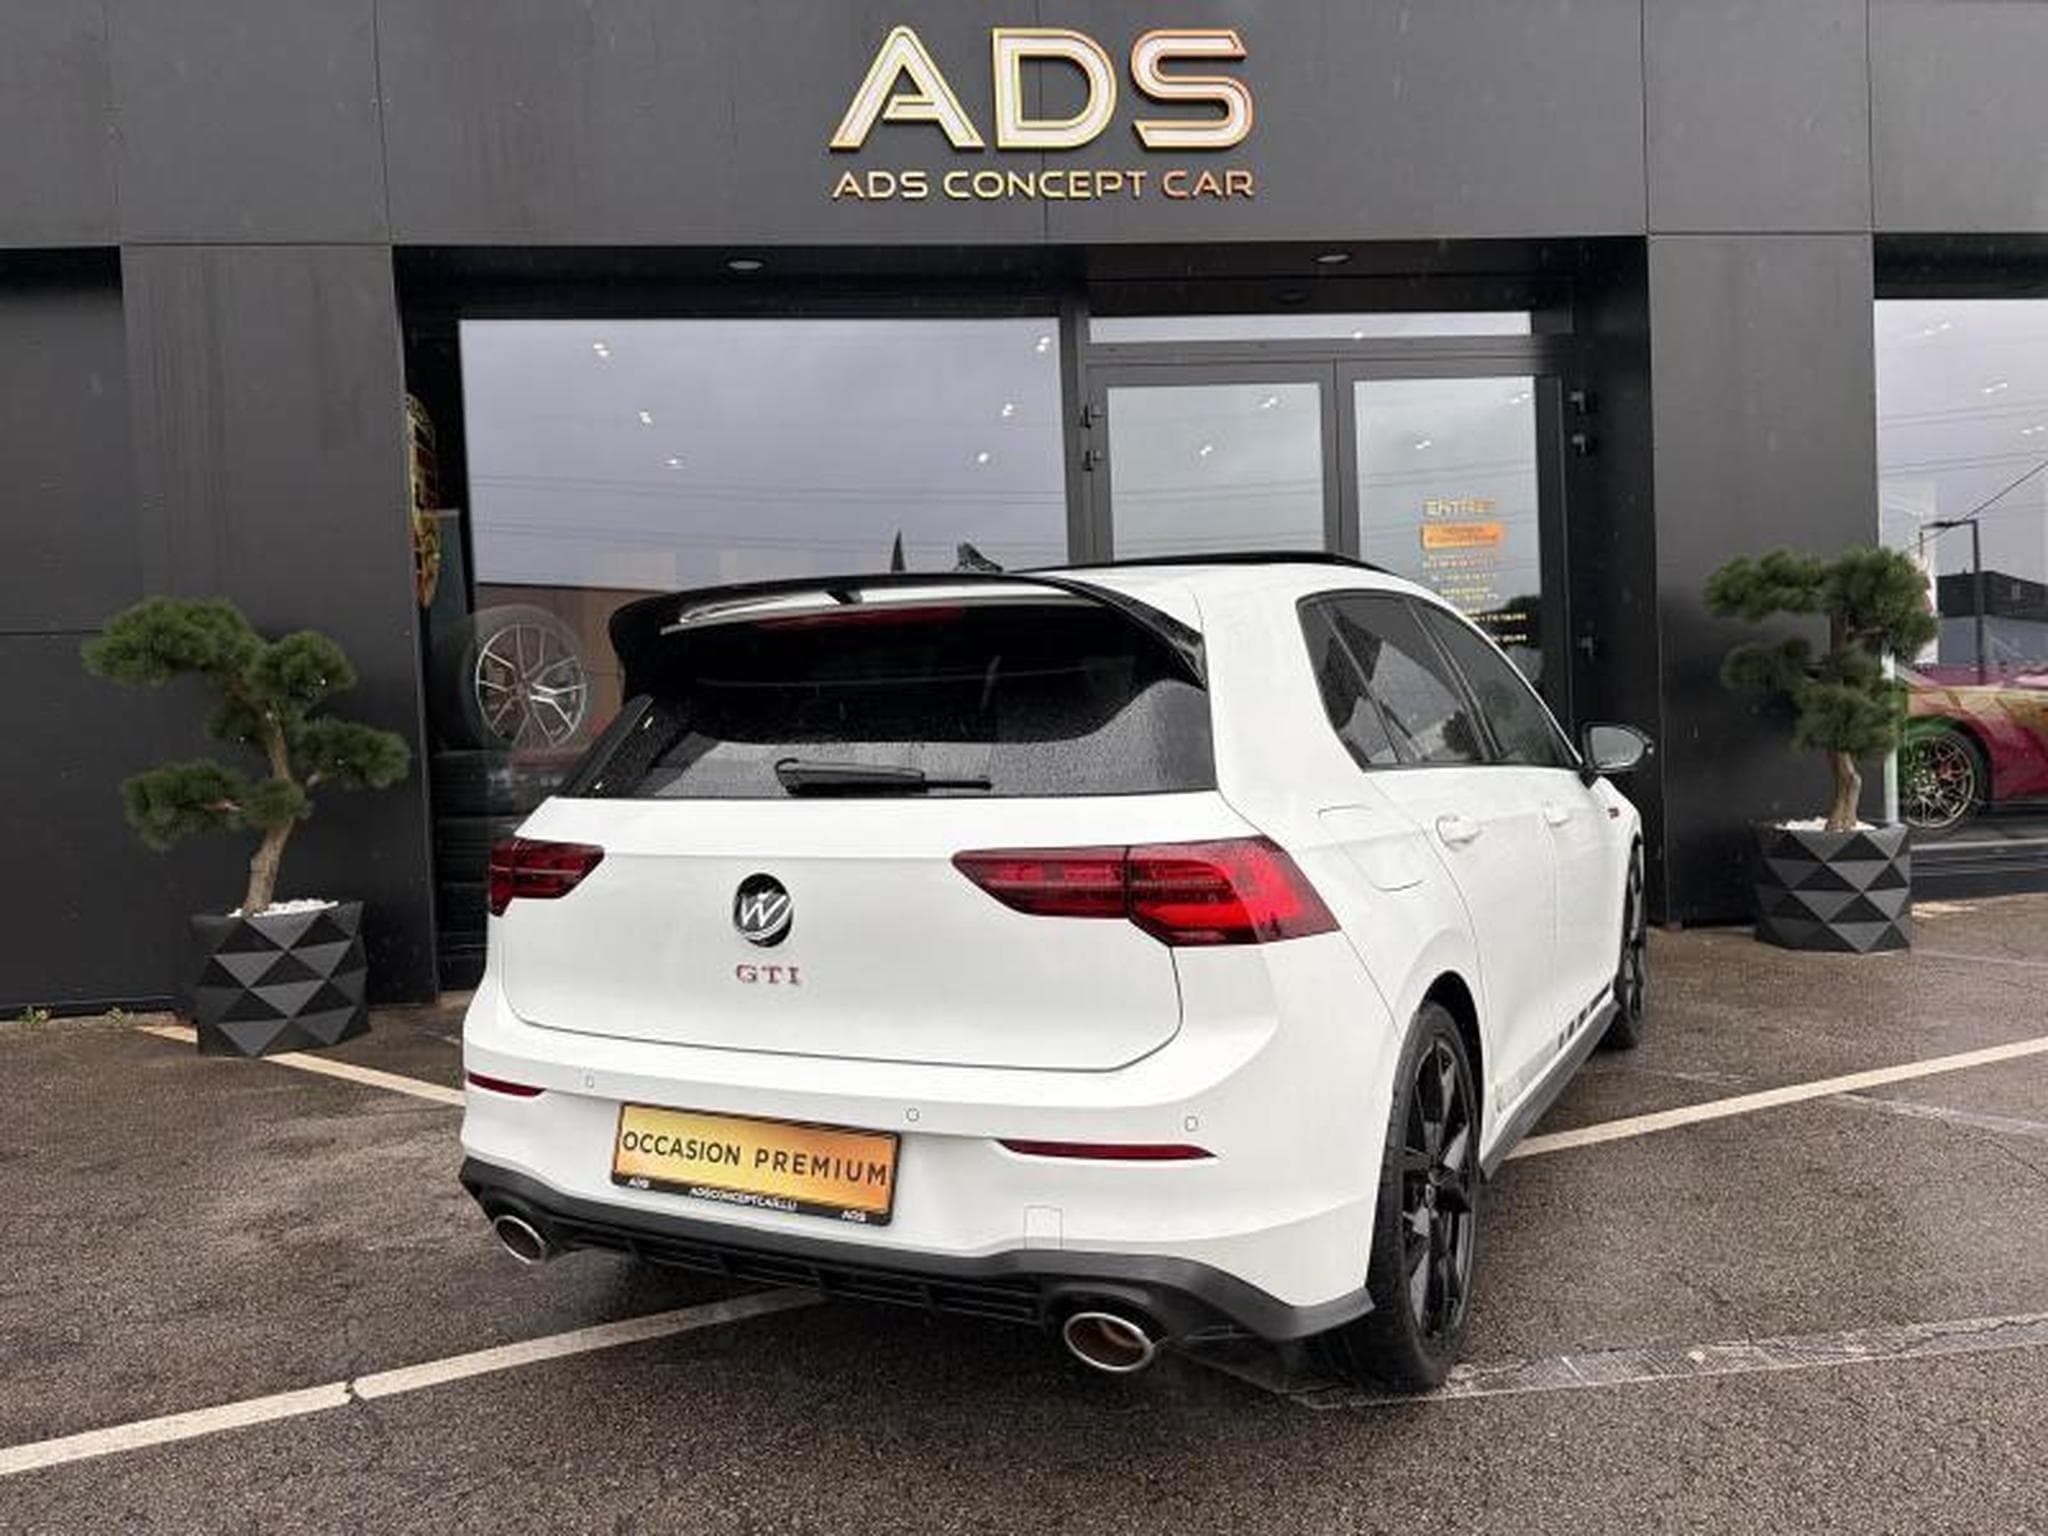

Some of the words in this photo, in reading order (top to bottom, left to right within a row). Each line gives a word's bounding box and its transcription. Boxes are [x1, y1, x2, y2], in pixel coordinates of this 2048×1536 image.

[830, 25, 1253, 149] ADS
[832, 170, 928, 199] ADS
[943, 170, 1147, 199] CONCEPT
[1163, 170, 1254, 198] CAR
[736, 964, 799, 985] GTI
[622, 1131, 741, 1166] OCCASION
[754, 1148, 887, 1186] PREMIUM
